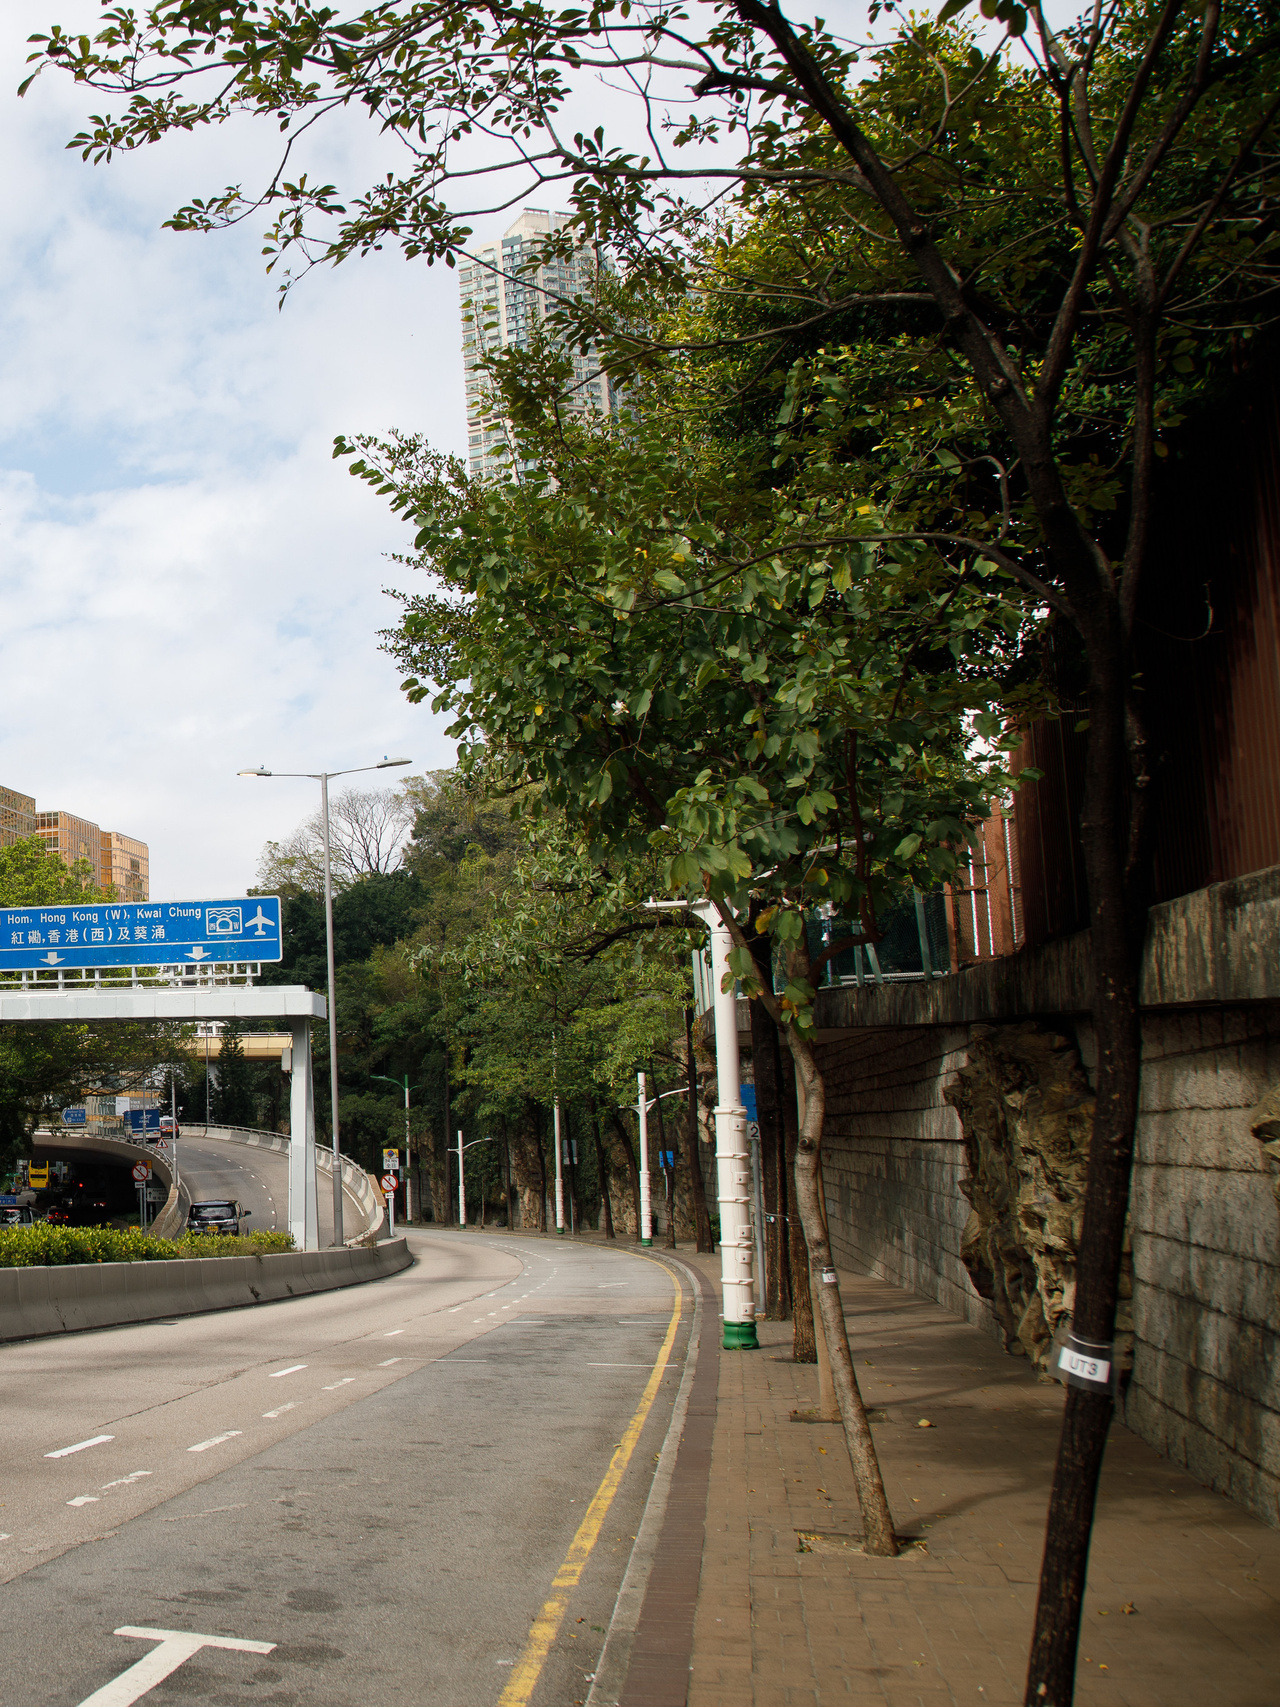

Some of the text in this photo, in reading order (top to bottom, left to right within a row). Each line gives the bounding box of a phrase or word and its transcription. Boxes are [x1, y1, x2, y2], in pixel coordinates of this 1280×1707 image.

[7, 914, 33, 925] Hom,
[40, 912, 66, 925] Hong
[72, 911, 99, 924] Kong
[105, 908, 131, 921] (W),
[136, 907, 162, 919] Kwai
[168, 906, 202, 919] Chung
[232, 921, 240, 930] W
[750, 1126, 759, 1138] 2
[1068, 1355, 1098, 1376] UT3
